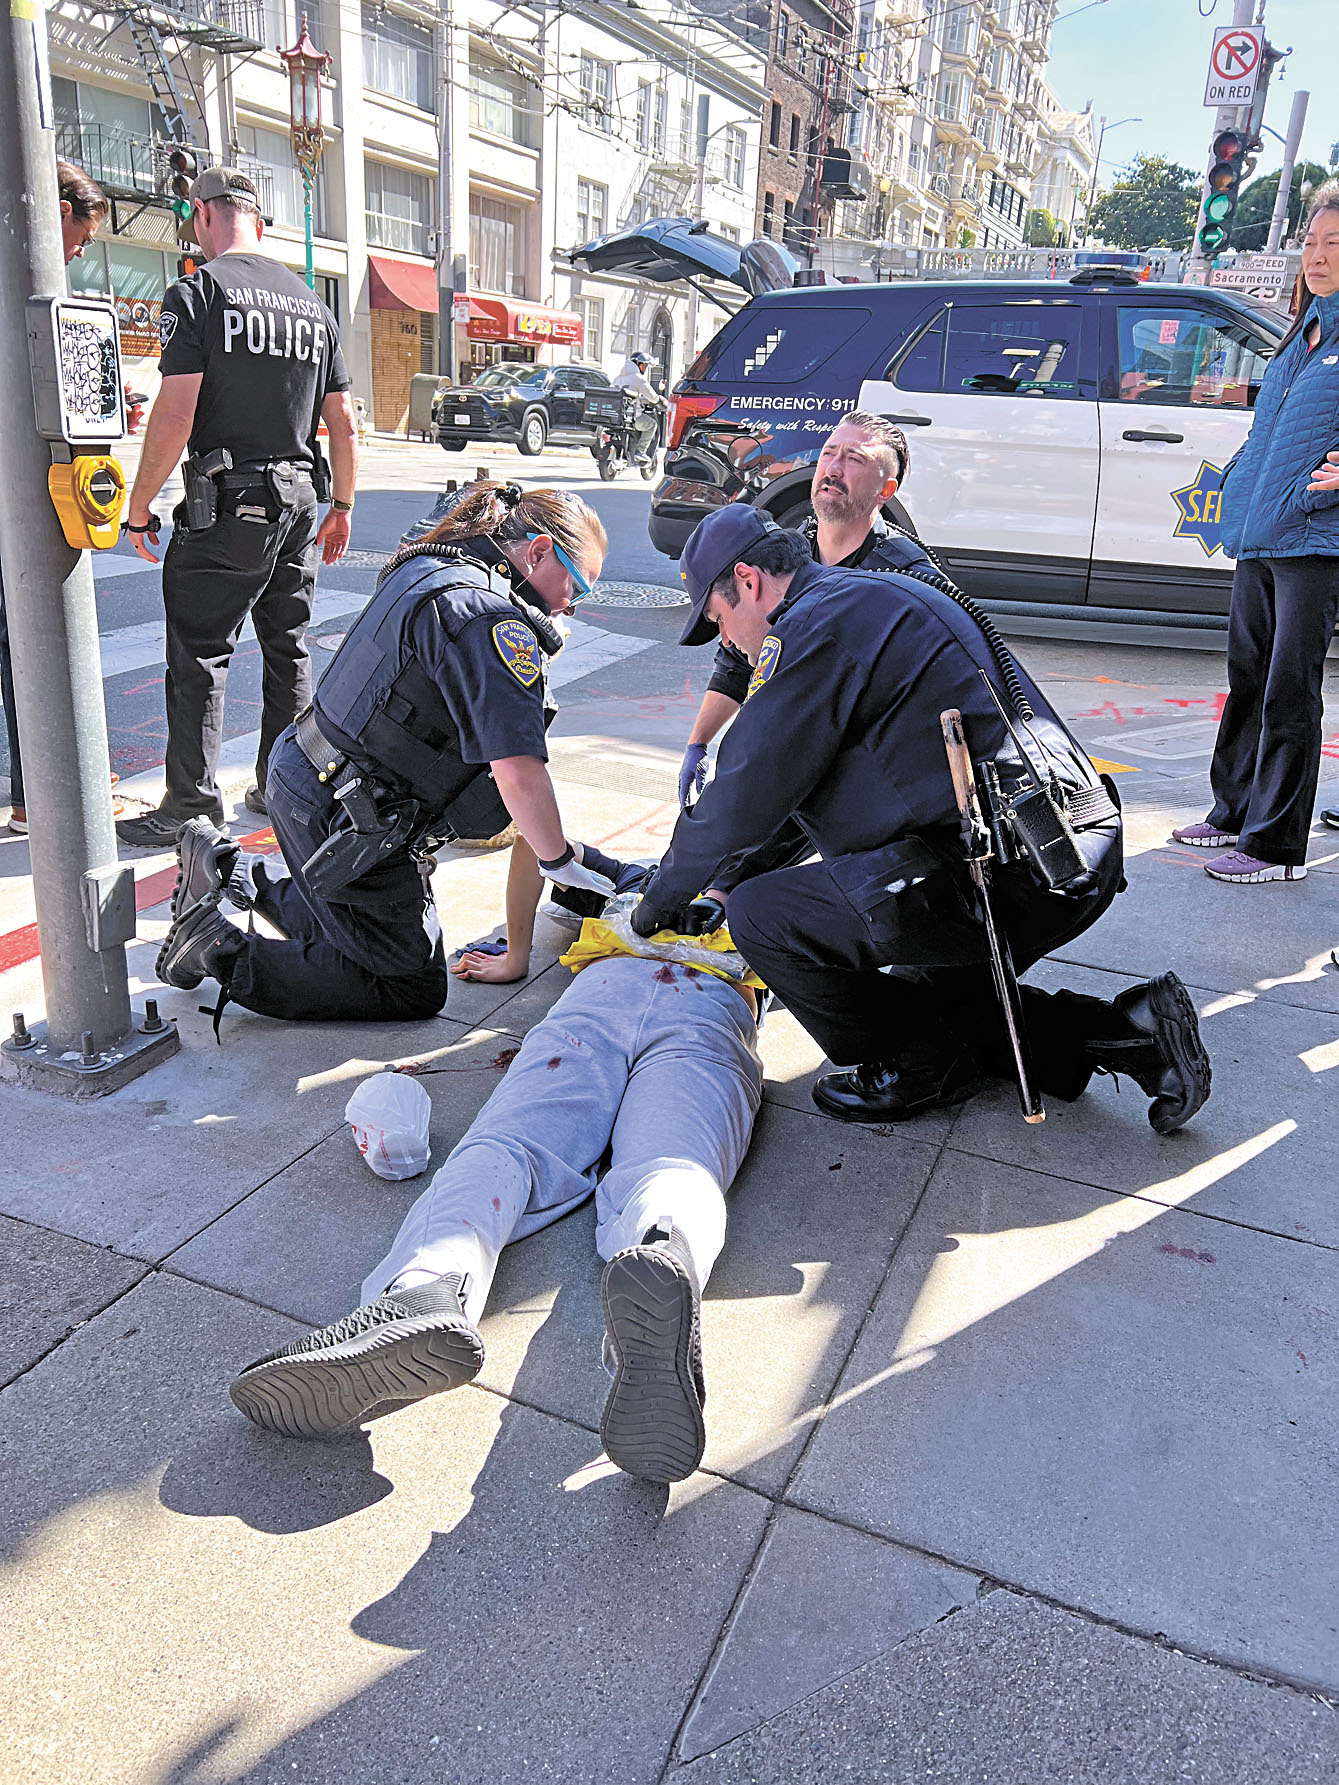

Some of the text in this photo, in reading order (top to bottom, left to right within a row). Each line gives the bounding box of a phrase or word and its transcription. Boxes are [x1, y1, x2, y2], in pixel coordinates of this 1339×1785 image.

[1209, 85, 1251, 99] ON RED
[1241, 261, 1255, 269] 900
[1214, 272, 1282, 285] Sacramento
[226, 287, 322, 320] SAN FRANCISCO
[223, 309, 327, 365] POLICE
[737, 417, 773, 432] Safety
[776, 420, 801, 431] with
